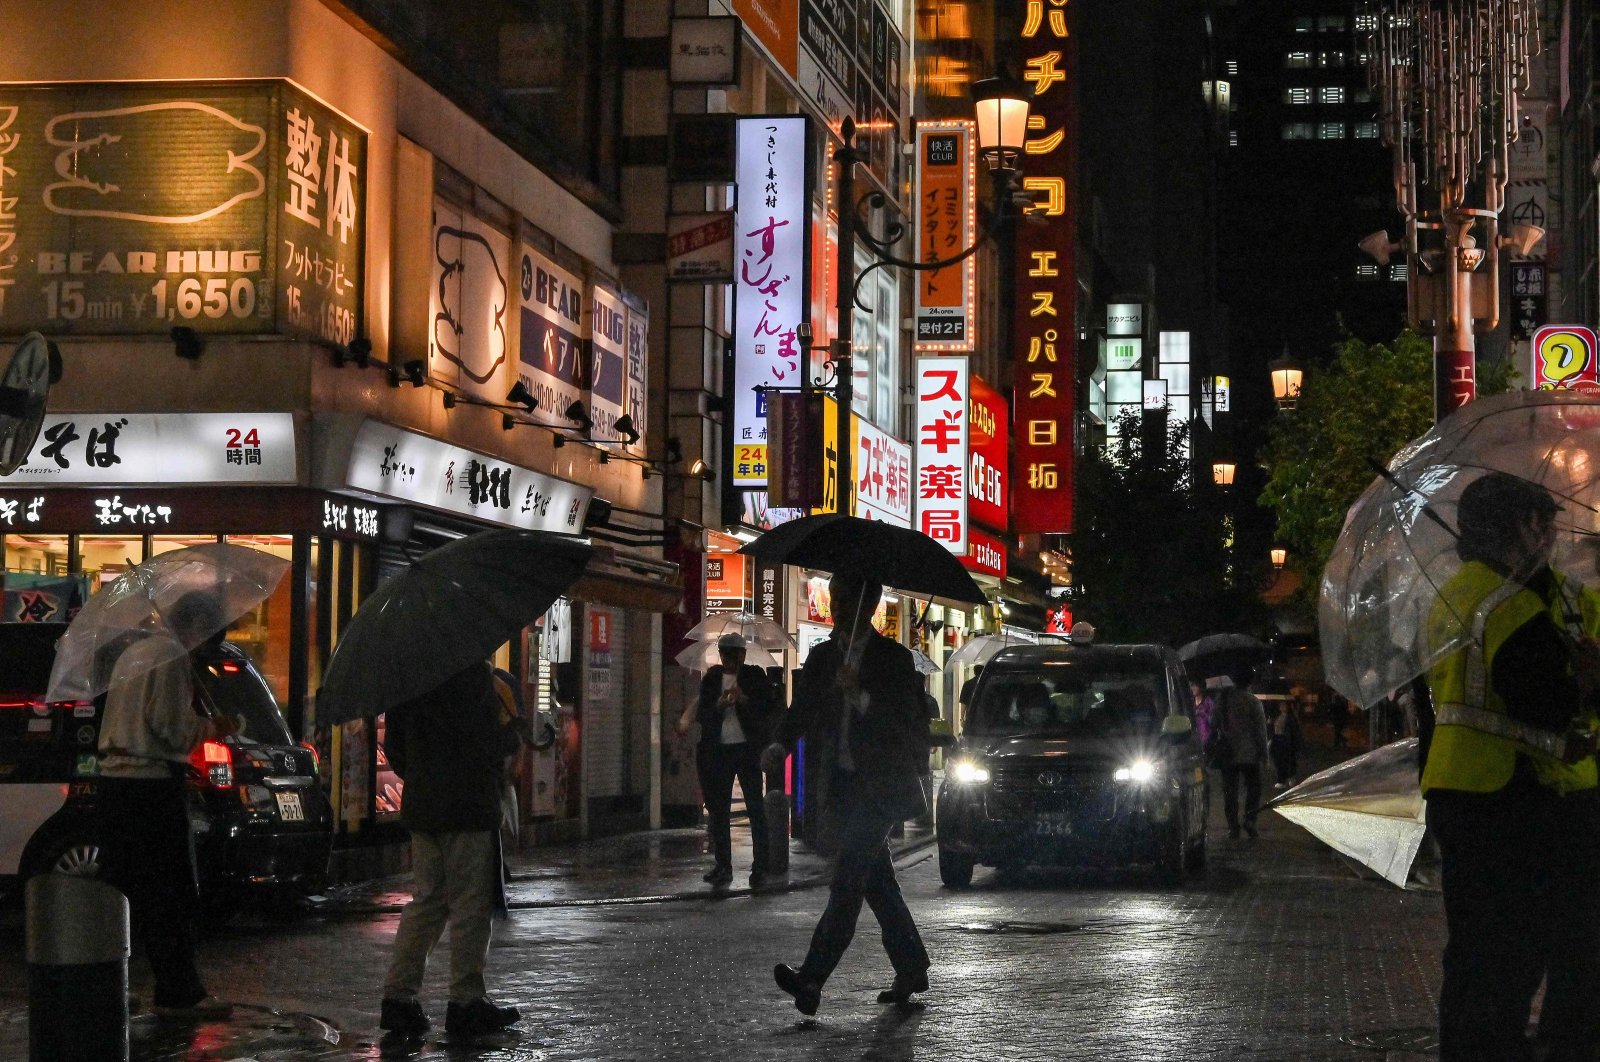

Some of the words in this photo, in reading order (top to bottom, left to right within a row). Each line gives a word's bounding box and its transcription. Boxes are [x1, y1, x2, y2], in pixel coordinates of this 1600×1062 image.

[930, 140, 953, 152] 快活
[930, 152, 953, 161] CLUB
[285, 107, 357, 244] 整体
[925, 188, 941, 295] インターネット
[944, 187, 958, 248] コミック
[37, 251, 157, 274] BEAR
[166, 250, 261, 273] HUG
[284, 239, 354, 296] フットセラピー
[535, 266, 582, 326] BEAR
[592, 298, 623, 345] HUG
[1026, 250, 1059, 490] エスパス日拓
[40, 417, 129, 469] そば
[225, 428, 261, 448] 24
[226, 448, 262, 466] 時間
[920, 370, 963, 543] スギ薬局
[859, 433, 909, 515] スギ薬局
[763, 569, 775, 620] 鍵付完全
